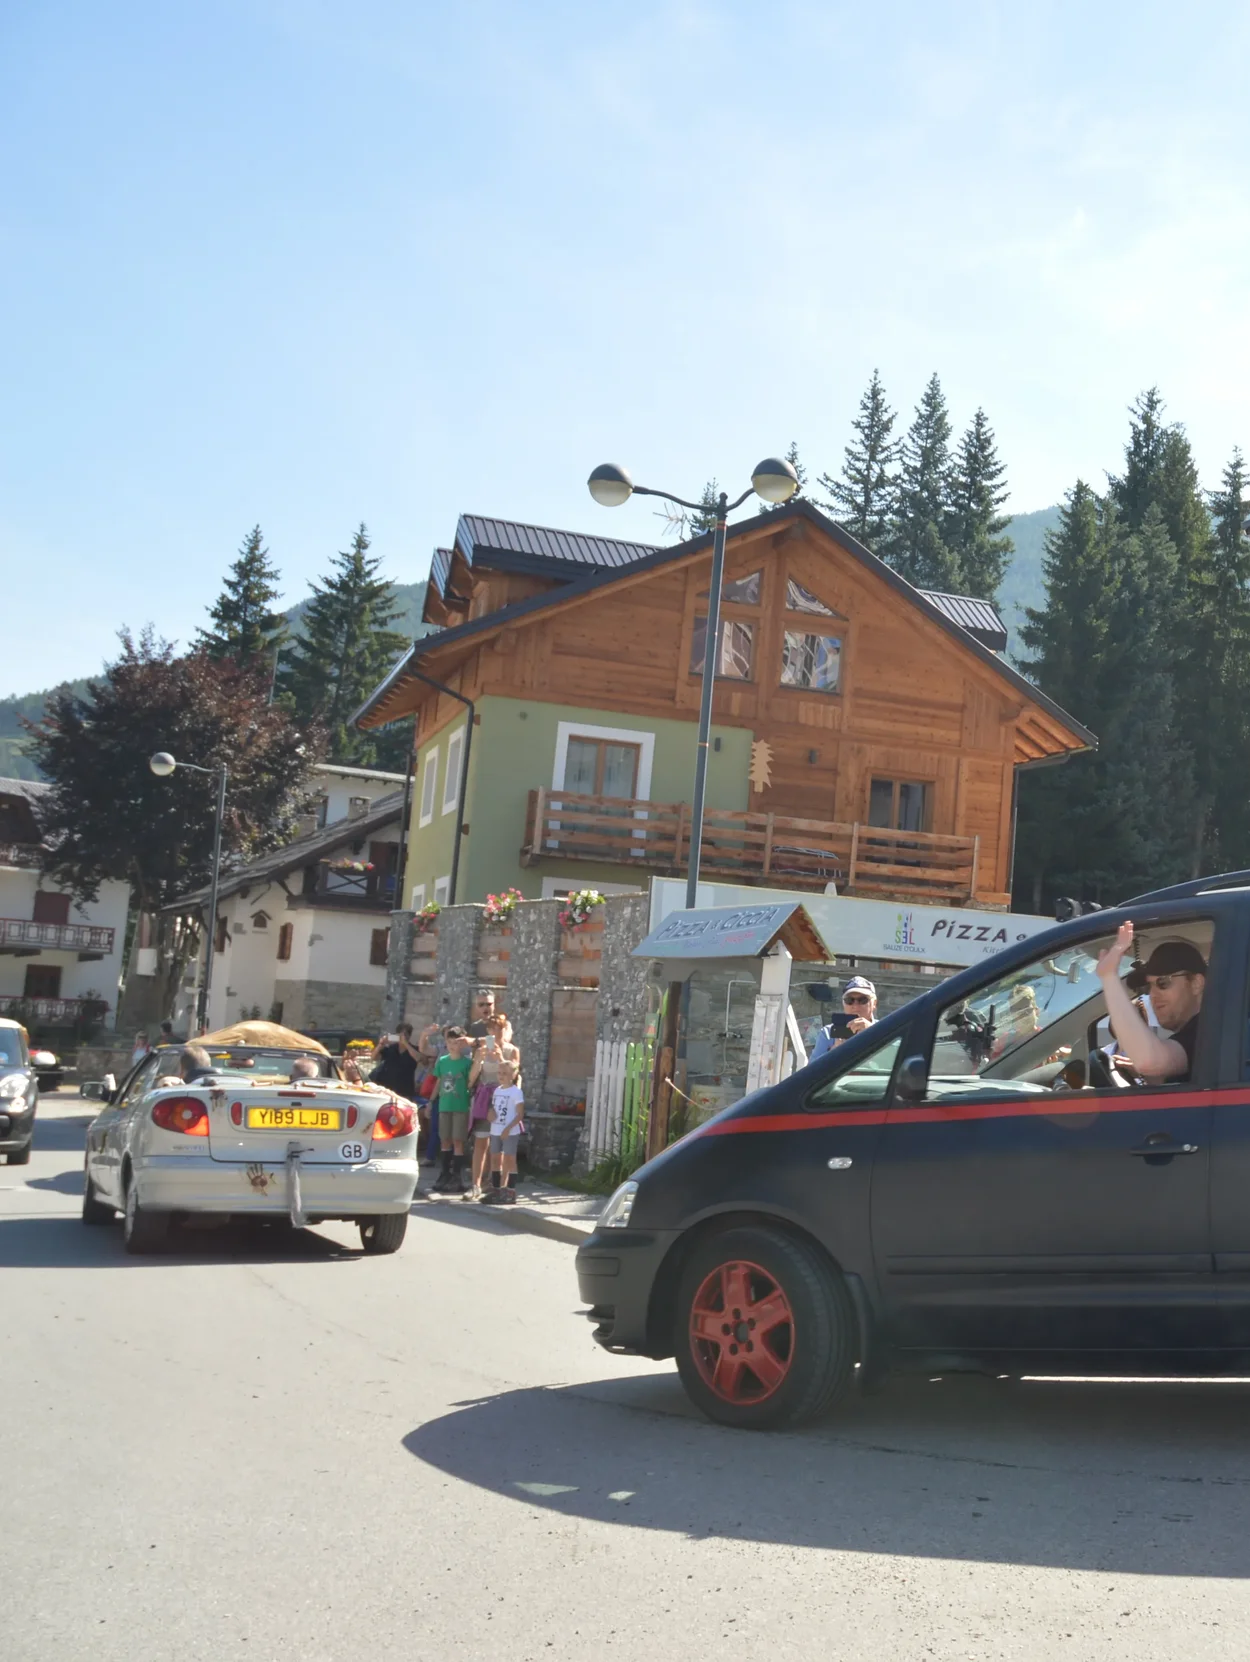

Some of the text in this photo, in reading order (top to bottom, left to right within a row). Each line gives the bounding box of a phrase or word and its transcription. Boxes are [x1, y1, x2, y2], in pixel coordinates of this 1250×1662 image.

[259, 1111, 330, 1126] Y189 LJB
[341, 1144, 362, 1159] GB
